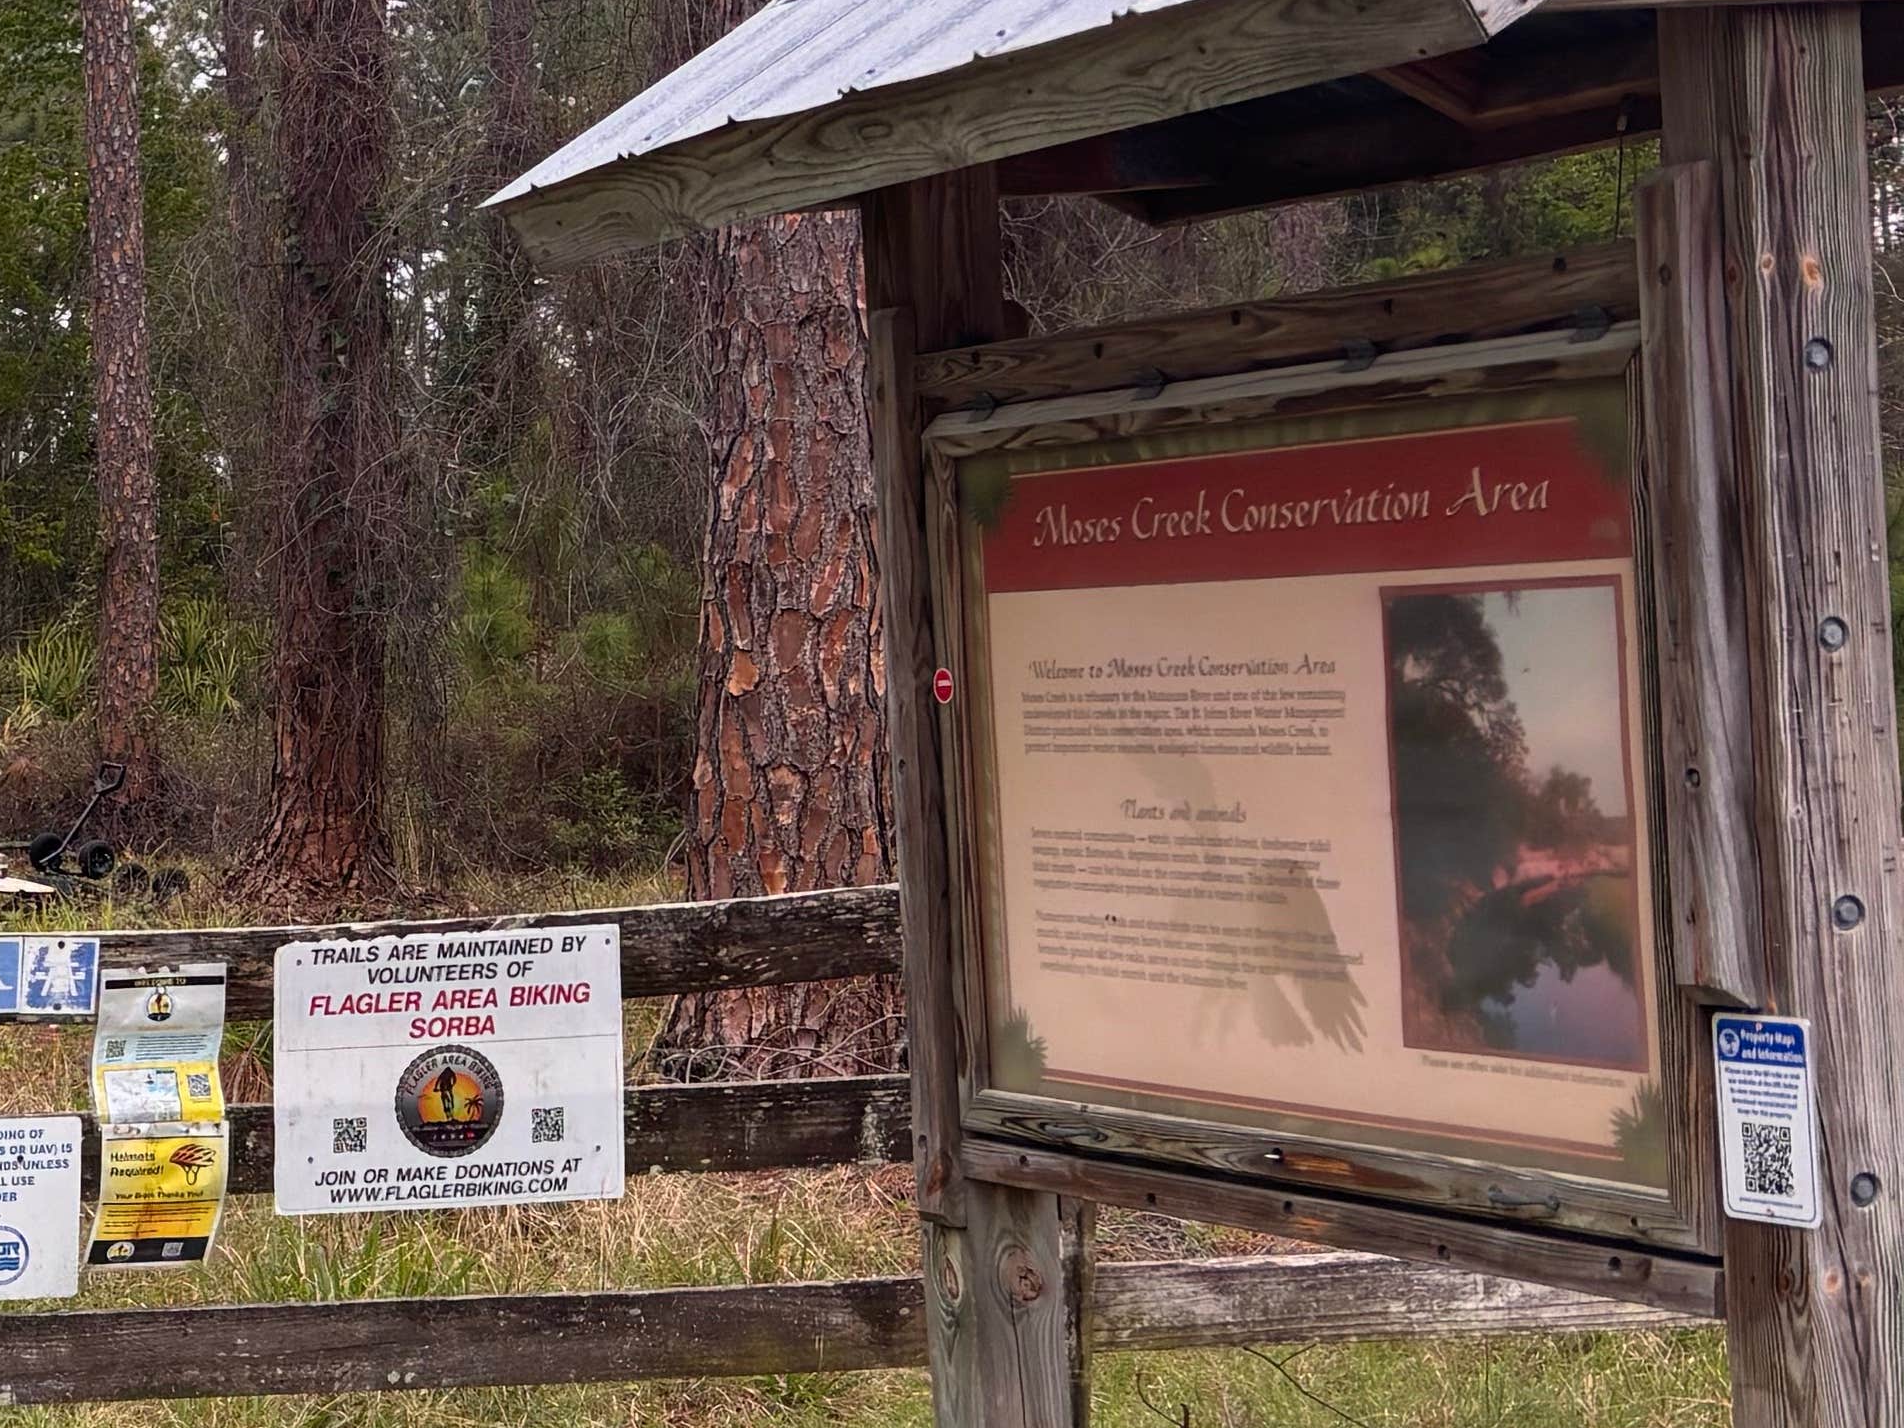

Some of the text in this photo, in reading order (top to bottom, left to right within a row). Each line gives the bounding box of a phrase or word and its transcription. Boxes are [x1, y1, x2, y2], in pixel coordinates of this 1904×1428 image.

[1033, 466, 1549, 547] Moses Creek Conservation Area
[1029, 653, 1336, 679] Welcome to Moses Creek Conservation Area
[1120, 798, 1165, 820] Plants
[311, 935, 587, 966] TRAILS ARE MAINTAINED BY
[367, 961, 534, 985] VOLUNTEERS OF
[309, 982, 591, 1017] FLAGLER AREA BIKING
[408, 1015, 496, 1039] SORBA
[1741, 1028, 1773, 1046] Property
[1741, 1048, 1804, 1063] and Information
[405, 1059, 439, 1095] FLAGLER
[441, 1055, 467, 1067] AREA
[29, 1129, 46, 1140] OF
[10, 1145, 26, 1155] OR
[30, 1144, 58, 1156] UAV)
[61, 1143, 73, 1153] IS
[110, 1152, 155, 1163] Helmets
[22, 1158, 70, 1170] UNLESS
[110, 1165, 164, 1177] Required!
[315, 1158, 583, 1187] JOIN OR MAKE DONATIONS AT
[12, 1175, 35, 1186] USE
[329, 1176, 568, 1204] WWW.FLAGLERBIKING.COM
